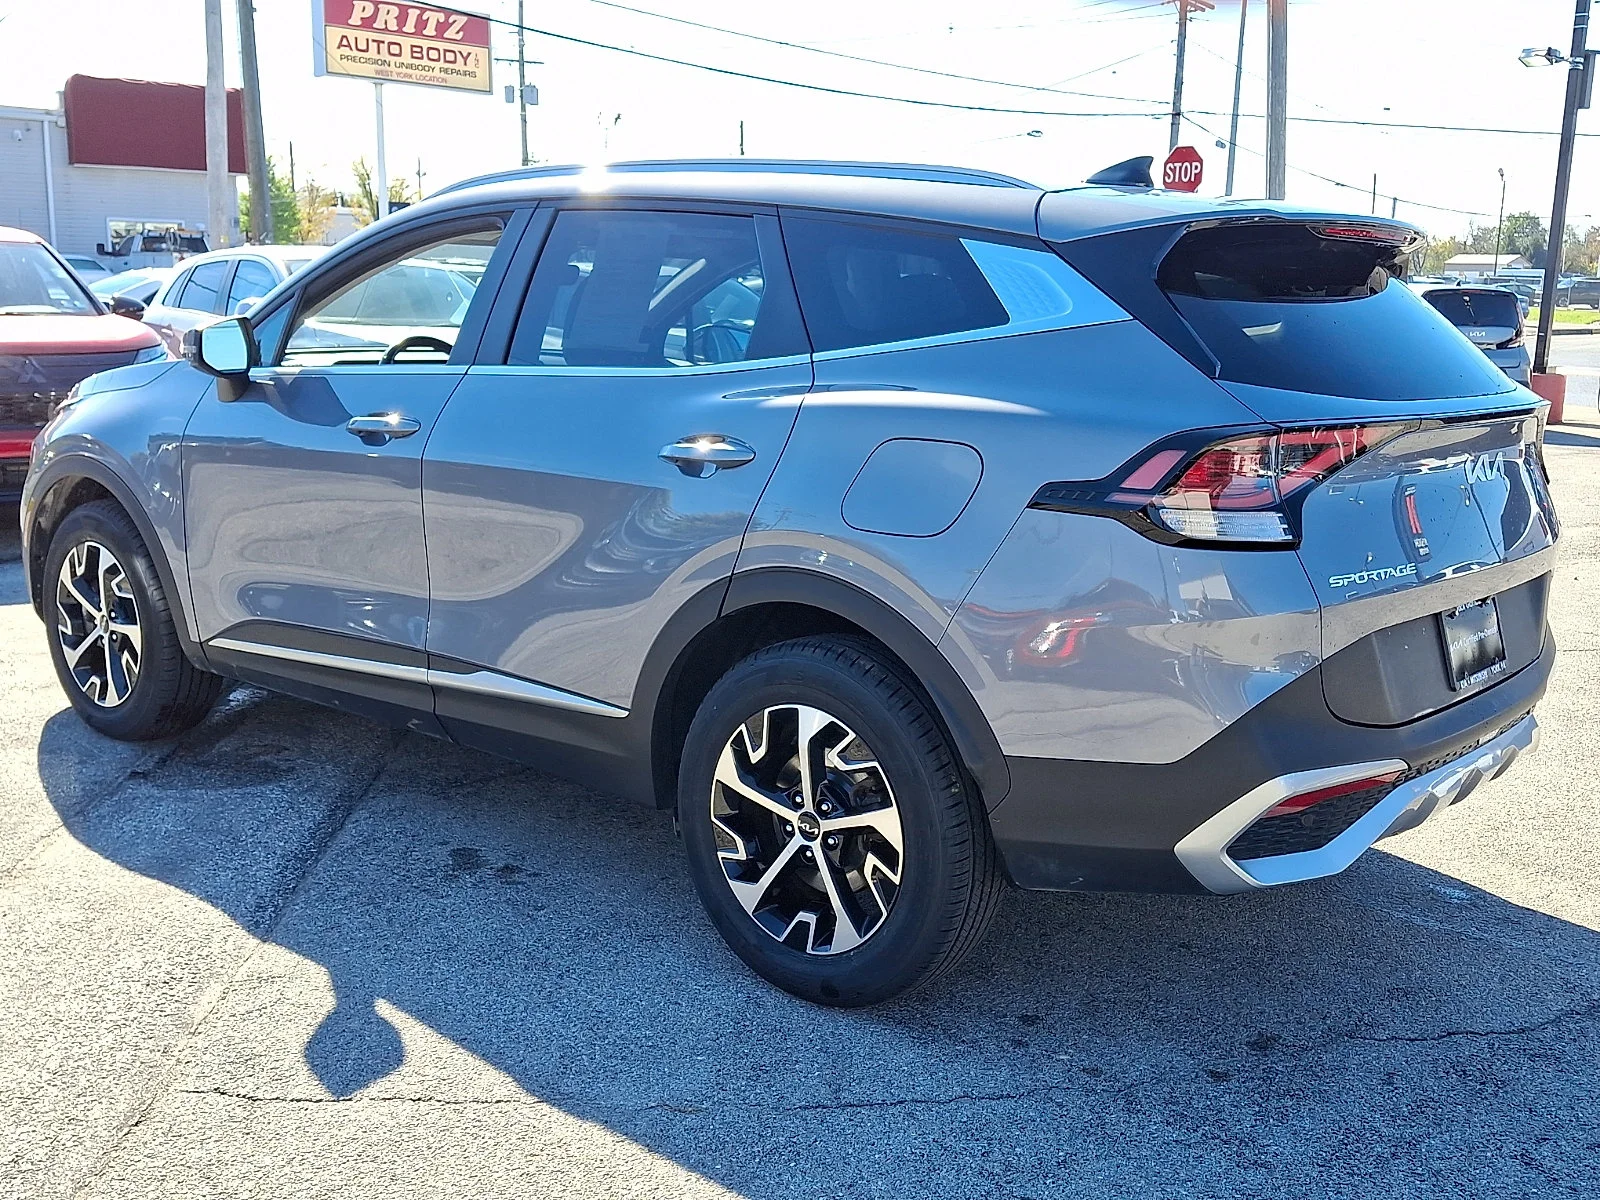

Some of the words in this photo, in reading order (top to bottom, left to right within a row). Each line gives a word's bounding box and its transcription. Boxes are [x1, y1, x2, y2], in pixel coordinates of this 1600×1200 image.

[347, 0, 468, 40] PRITZ
[336, 34, 403, 57] AUTO
[410, 44, 472, 66] BODY
[340, 53, 391, 68] PRECISION
[394, 60, 436, 73] UNIBODY
[439, 66, 477, 79] REPAIRS
[374, 69, 393, 78] WEST
[395, 71, 414, 81] YORK
[415, 74, 448, 84] LOCATION
[1165, 161, 1201, 183] STOP
[1464, 451, 1505, 484] KIA
[1328, 562, 1418, 588] SPORTAGE
